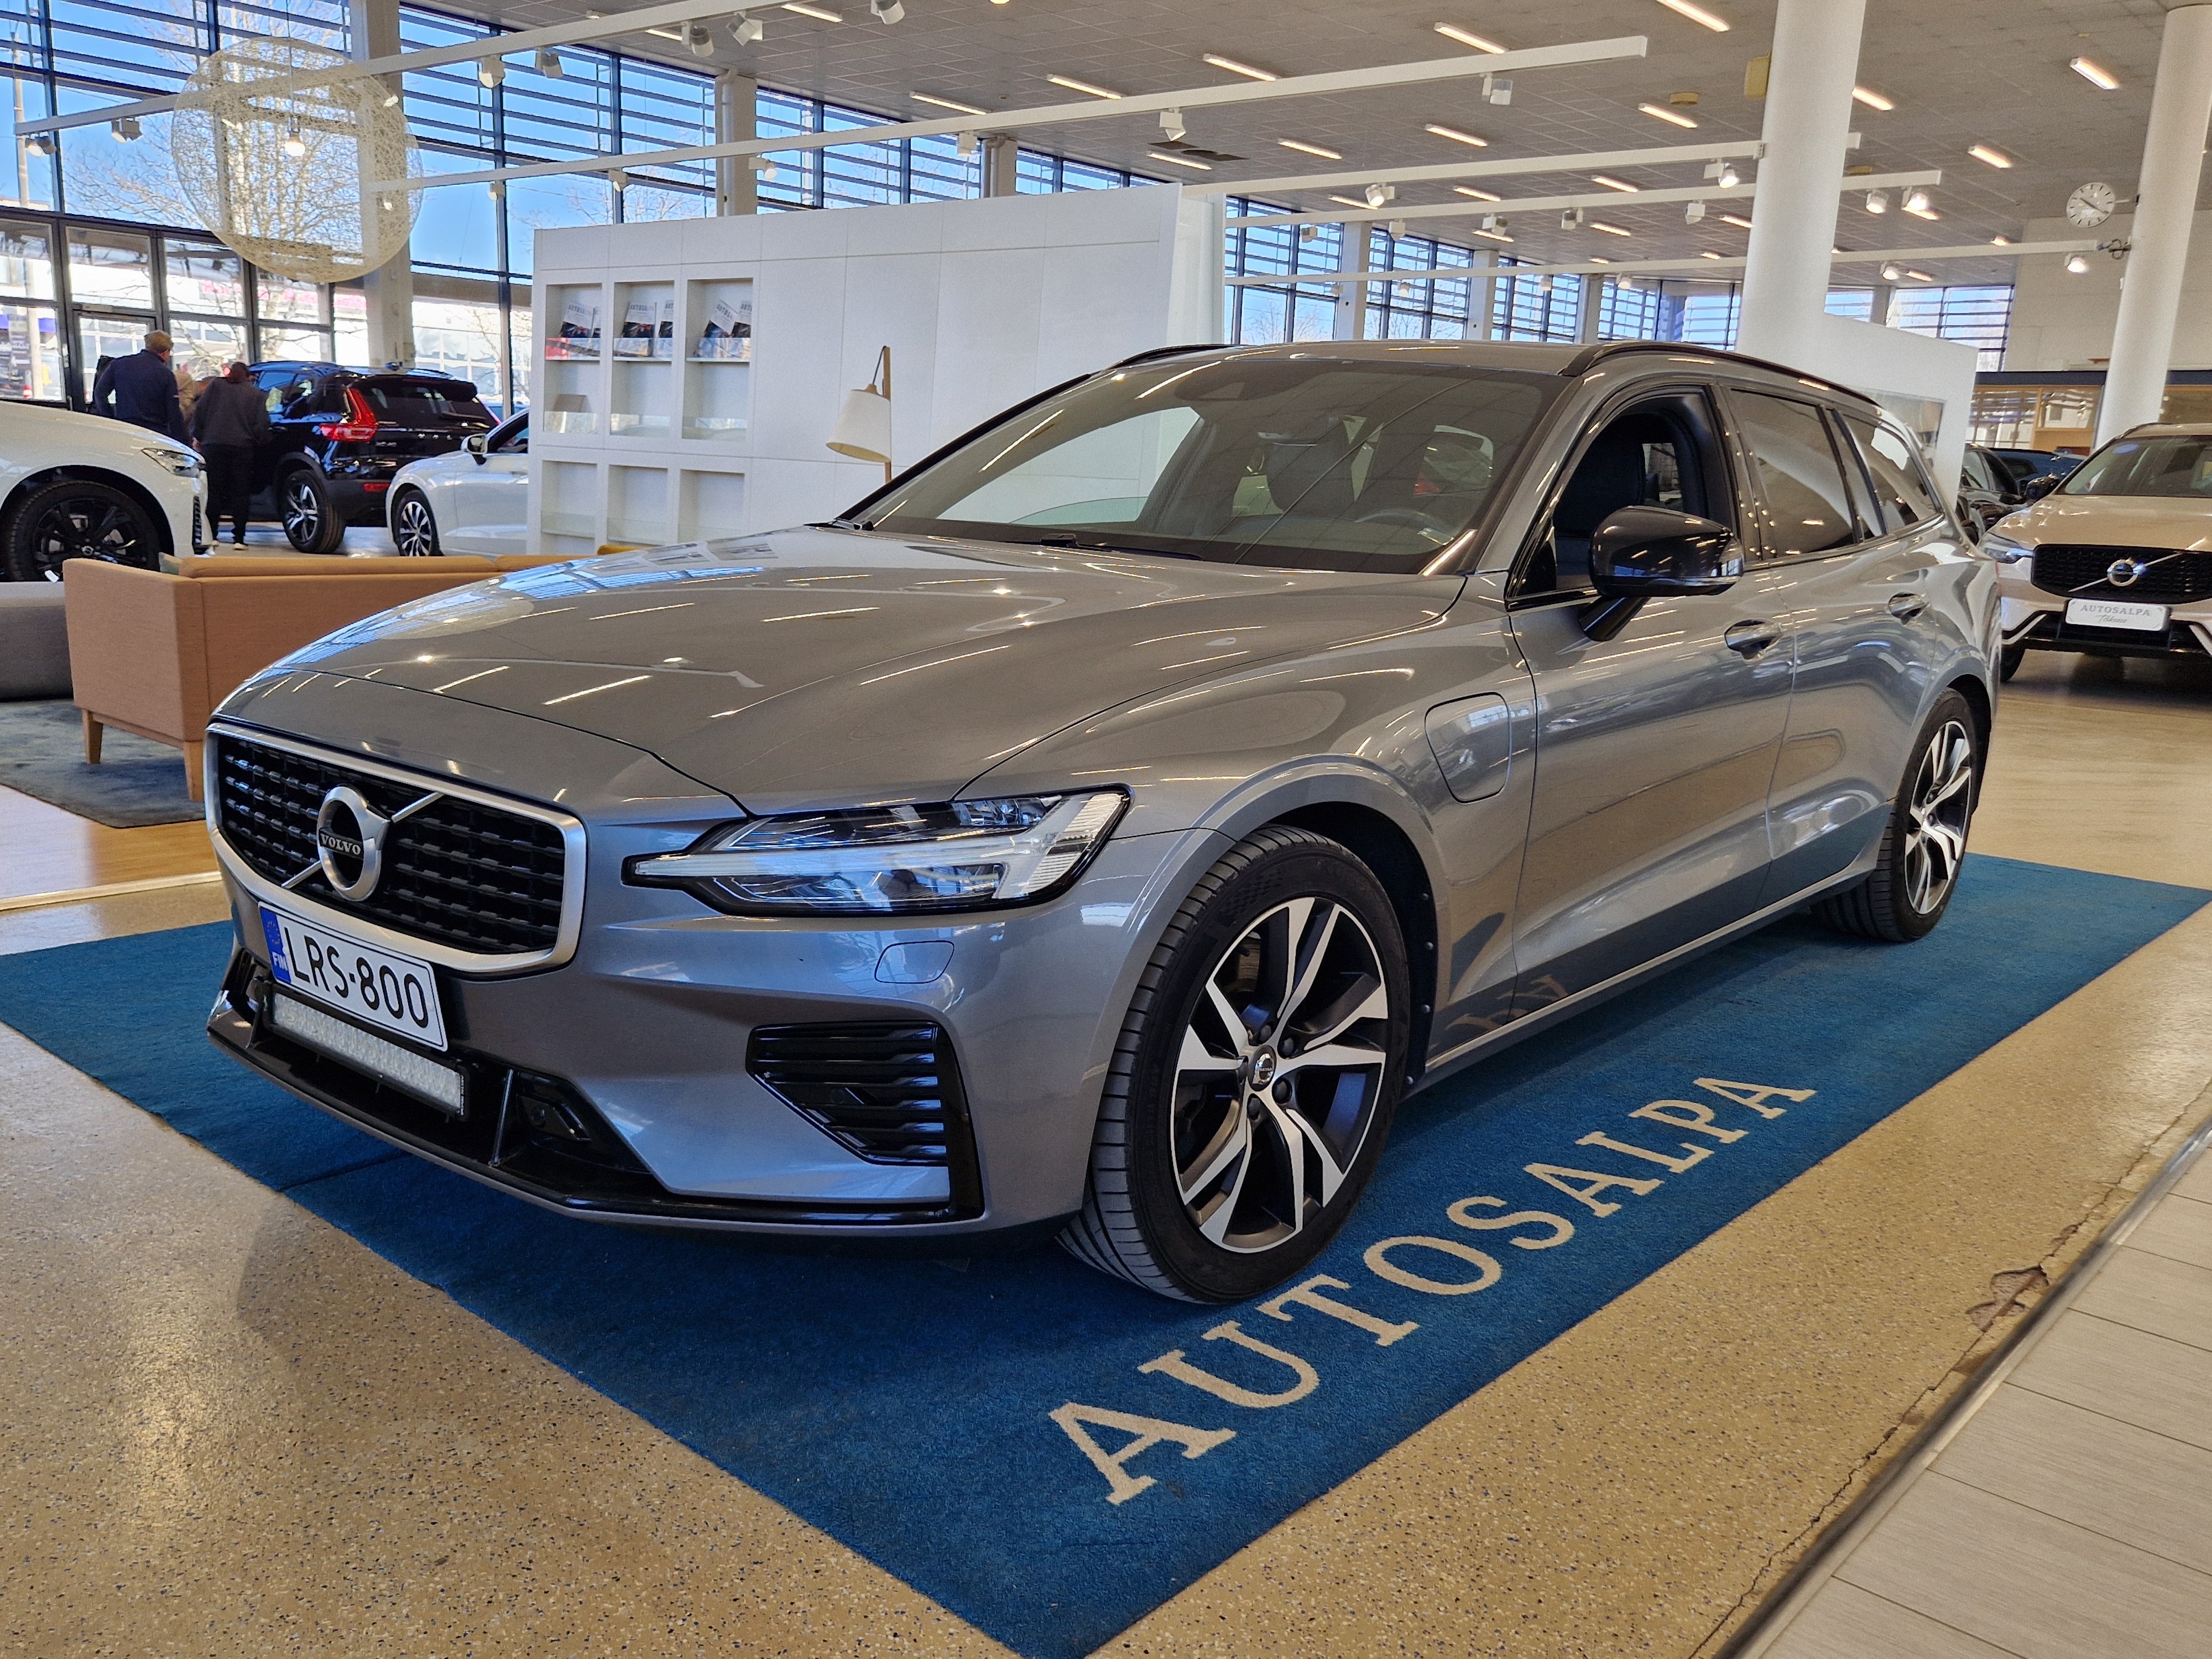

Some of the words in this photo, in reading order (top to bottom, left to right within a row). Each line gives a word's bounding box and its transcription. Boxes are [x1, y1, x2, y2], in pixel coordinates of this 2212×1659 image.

[2080, 604, 2150, 617] AUTOSALPA
[320, 833, 361, 855] VOLVO
[271, 951, 289, 971] FIN
[284, 927, 428, 1028] LRS-800
[1048, 1076, 1818, 1506] AUTOSALPA
